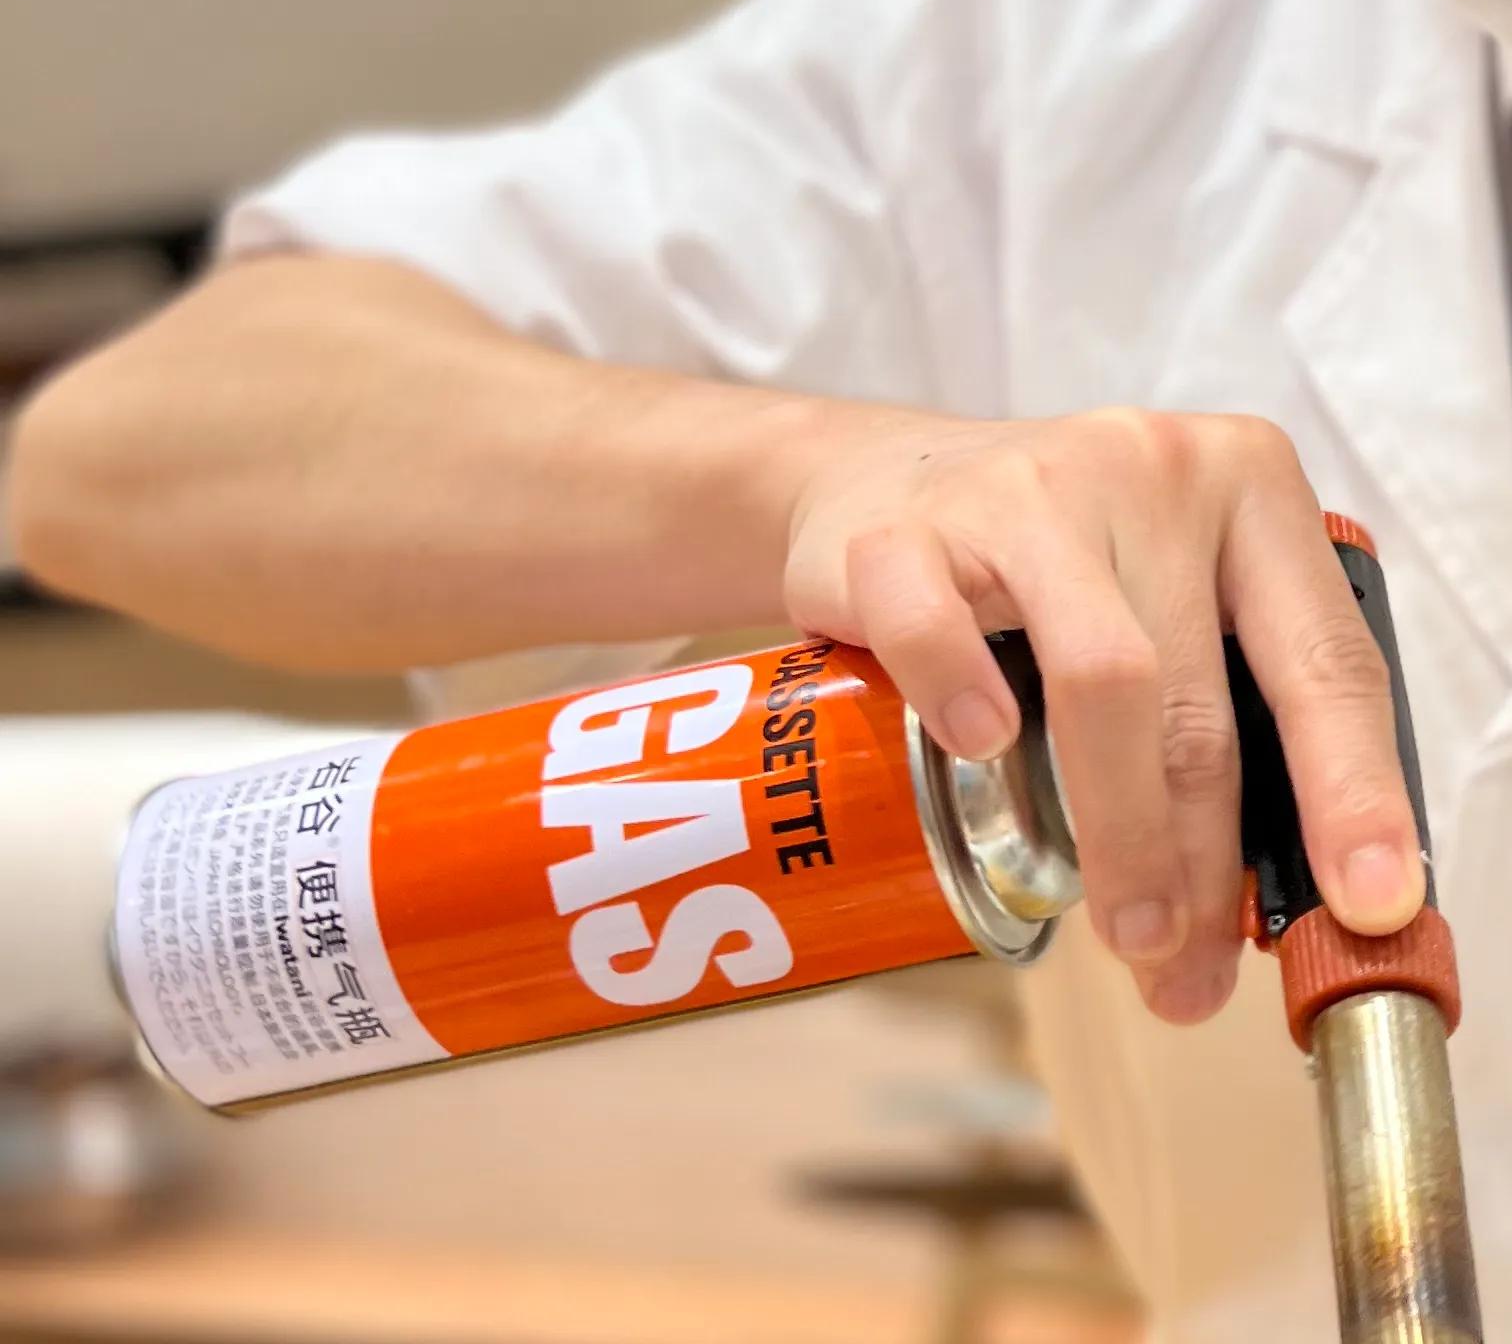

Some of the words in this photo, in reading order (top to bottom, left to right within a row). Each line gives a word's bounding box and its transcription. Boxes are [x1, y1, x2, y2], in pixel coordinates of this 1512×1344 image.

[300, 756, 360, 835] 岩谷
[763, 643, 834, 875] CASSETTE
[205, 846, 221, 897] JAPAN
[542, 663, 794, 1007] GAS
[274, 915, 313, 998] Iwatani
[296, 860, 390, 1045] 便携气瓶
